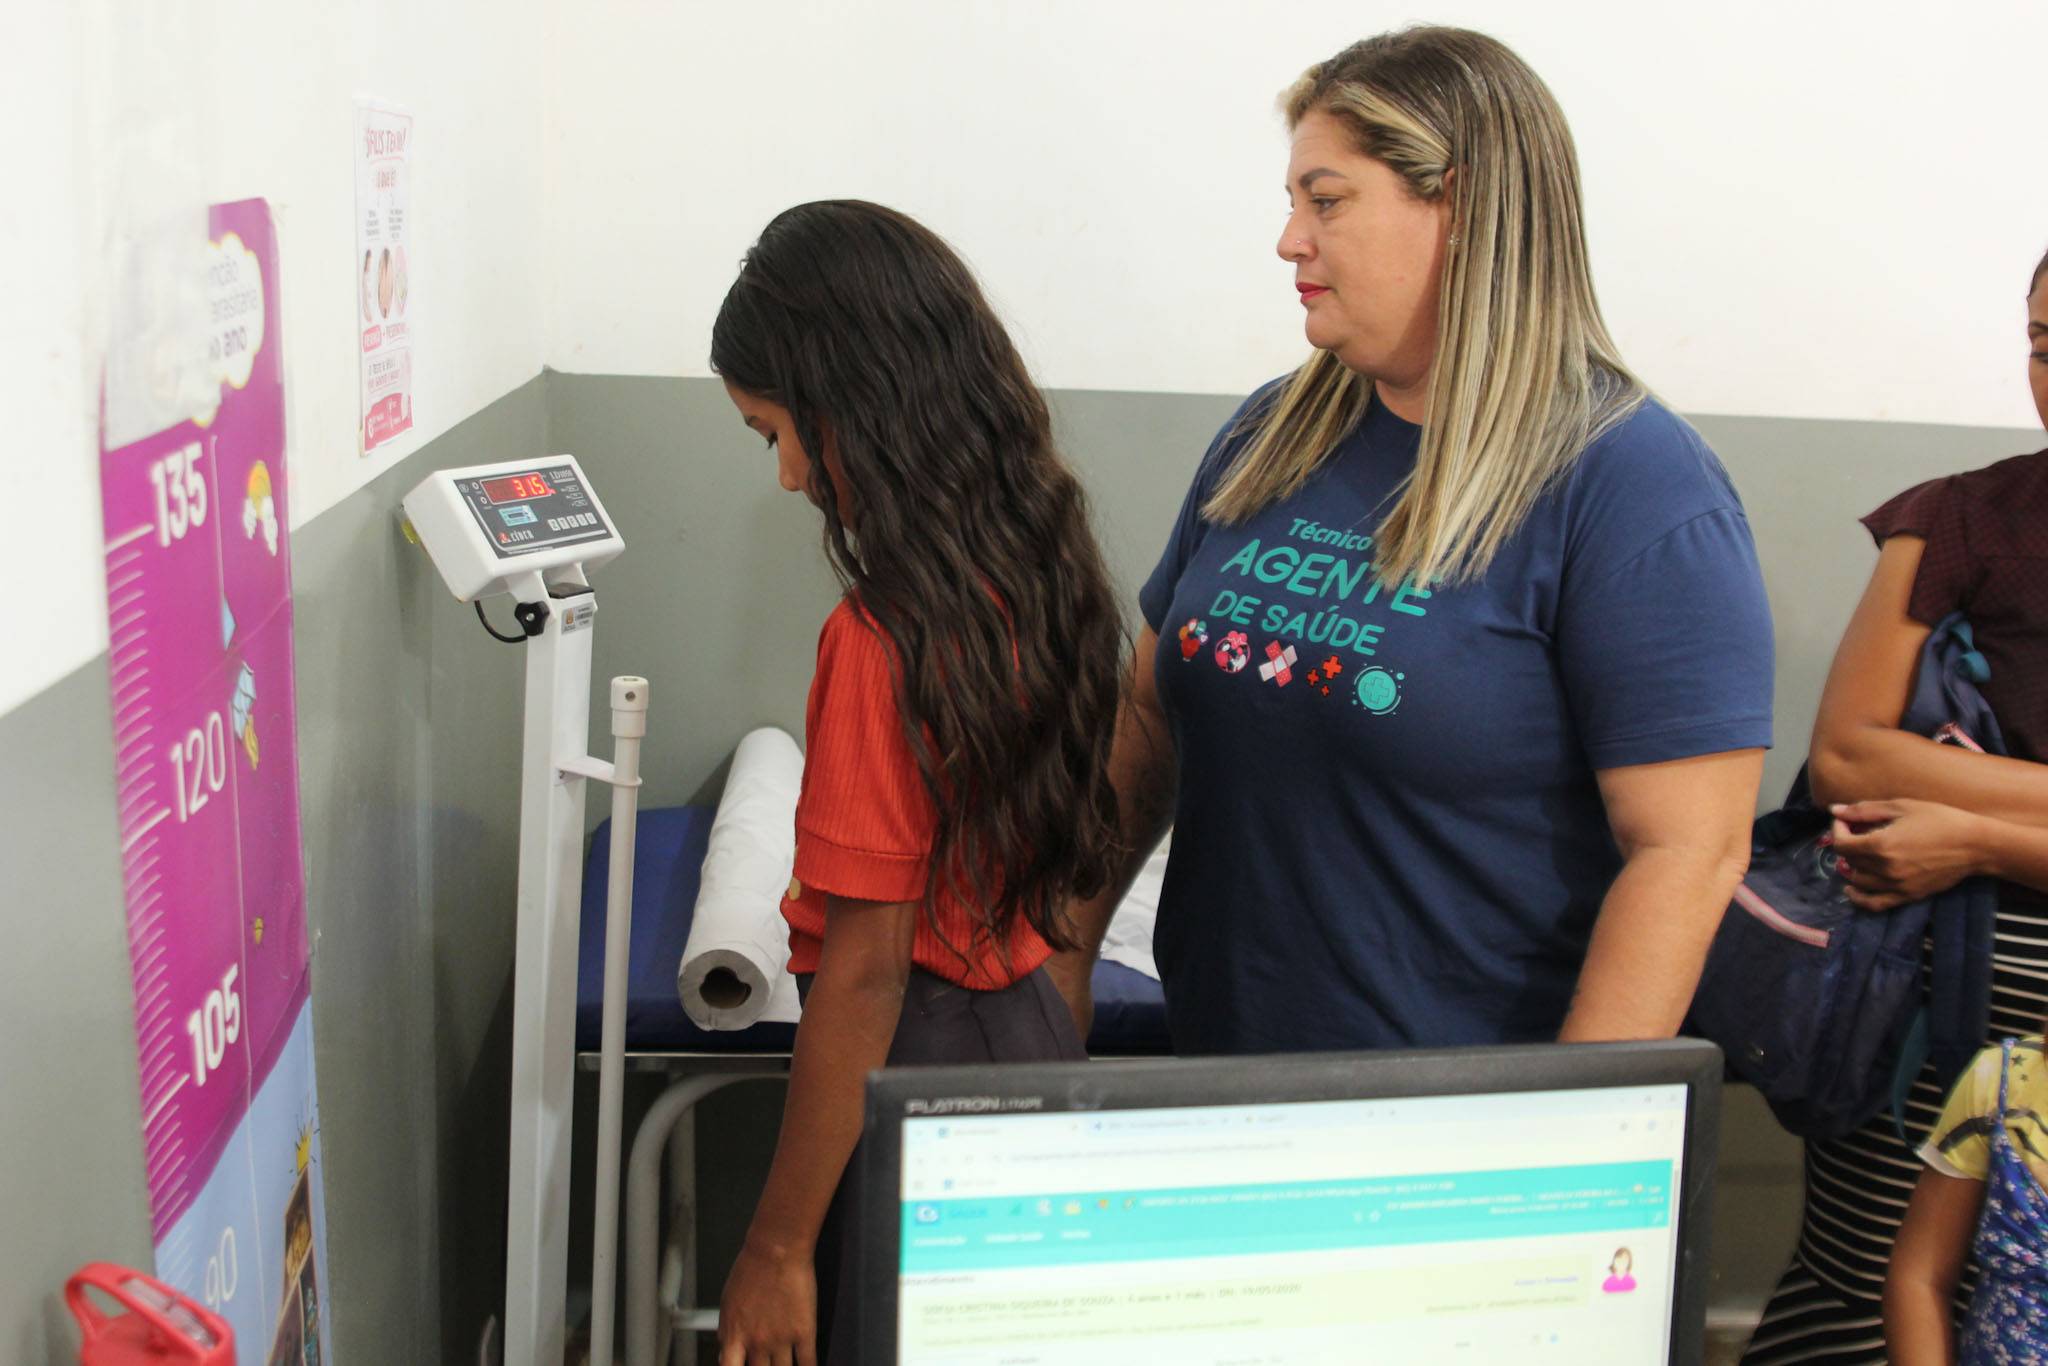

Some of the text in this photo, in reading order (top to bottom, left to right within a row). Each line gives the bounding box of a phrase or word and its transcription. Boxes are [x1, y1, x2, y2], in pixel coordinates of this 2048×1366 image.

[150, 441, 208, 549] 135
[1288, 518, 1373, 551] Técnico
[1209, 590, 1386, 656] DE SAÚDE
[170, 711, 226, 824] 120
[187, 963, 241, 1088] 105
[904, 1096, 1000, 1114] FLATRON
[205, 1226, 238, 1314] 90
